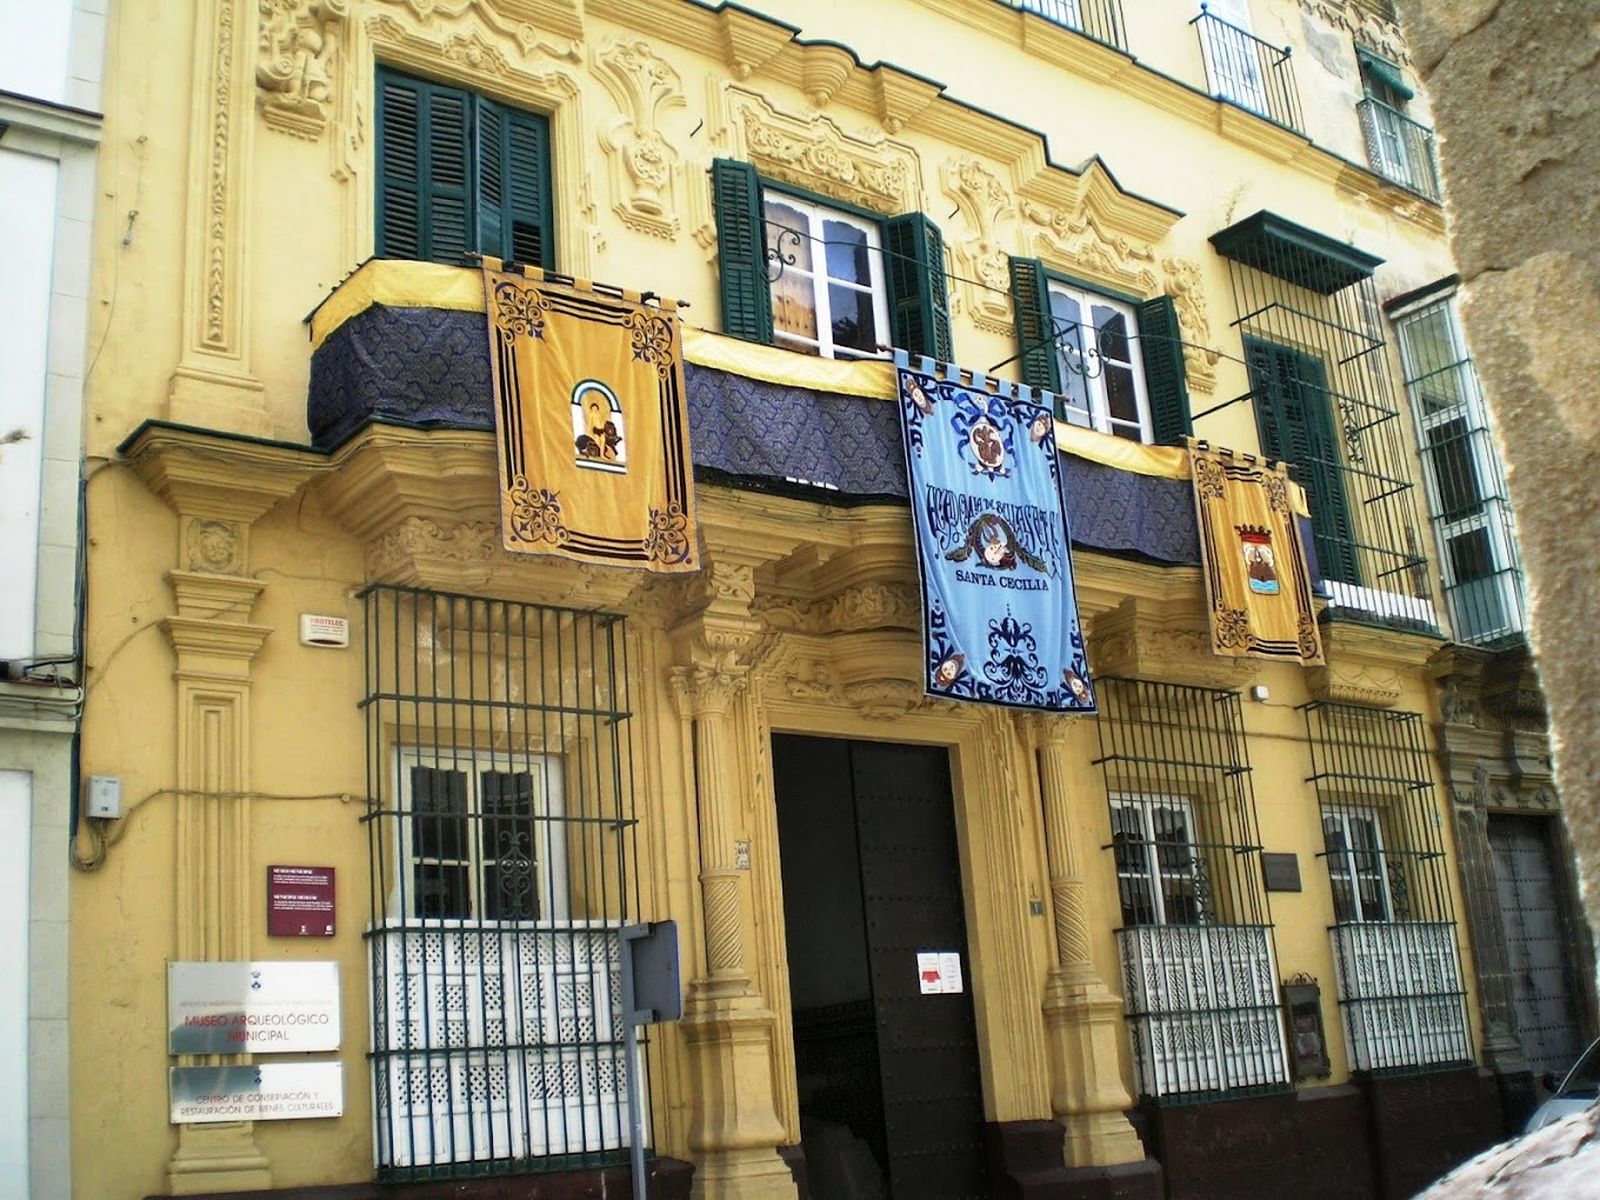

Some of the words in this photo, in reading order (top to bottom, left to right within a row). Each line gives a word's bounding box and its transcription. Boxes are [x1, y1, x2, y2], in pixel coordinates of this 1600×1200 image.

[955, 569, 996, 587] SANTA
[1000, 576, 1049, 591] CECILIA
[184, 1015, 228, 1027] MUSEO
[231, 1012, 330, 1027] ARQUEOLÓGICO
[227, 1030, 290, 1042] MUNICIPAL
[195, 1094, 229, 1105] CENTRO
[232, 1094, 244, 1103] DE
[246, 1091, 310, 1103] CONSERVACIÓN
[312, 1092, 320, 1100] Y
[180, 1103, 242, 1116] RESTAURACIÓN
[244, 1105, 255, 1114] DE
[258, 1104, 285, 1113] BIENES
[287, 1103, 334, 1112] CULTURALES
